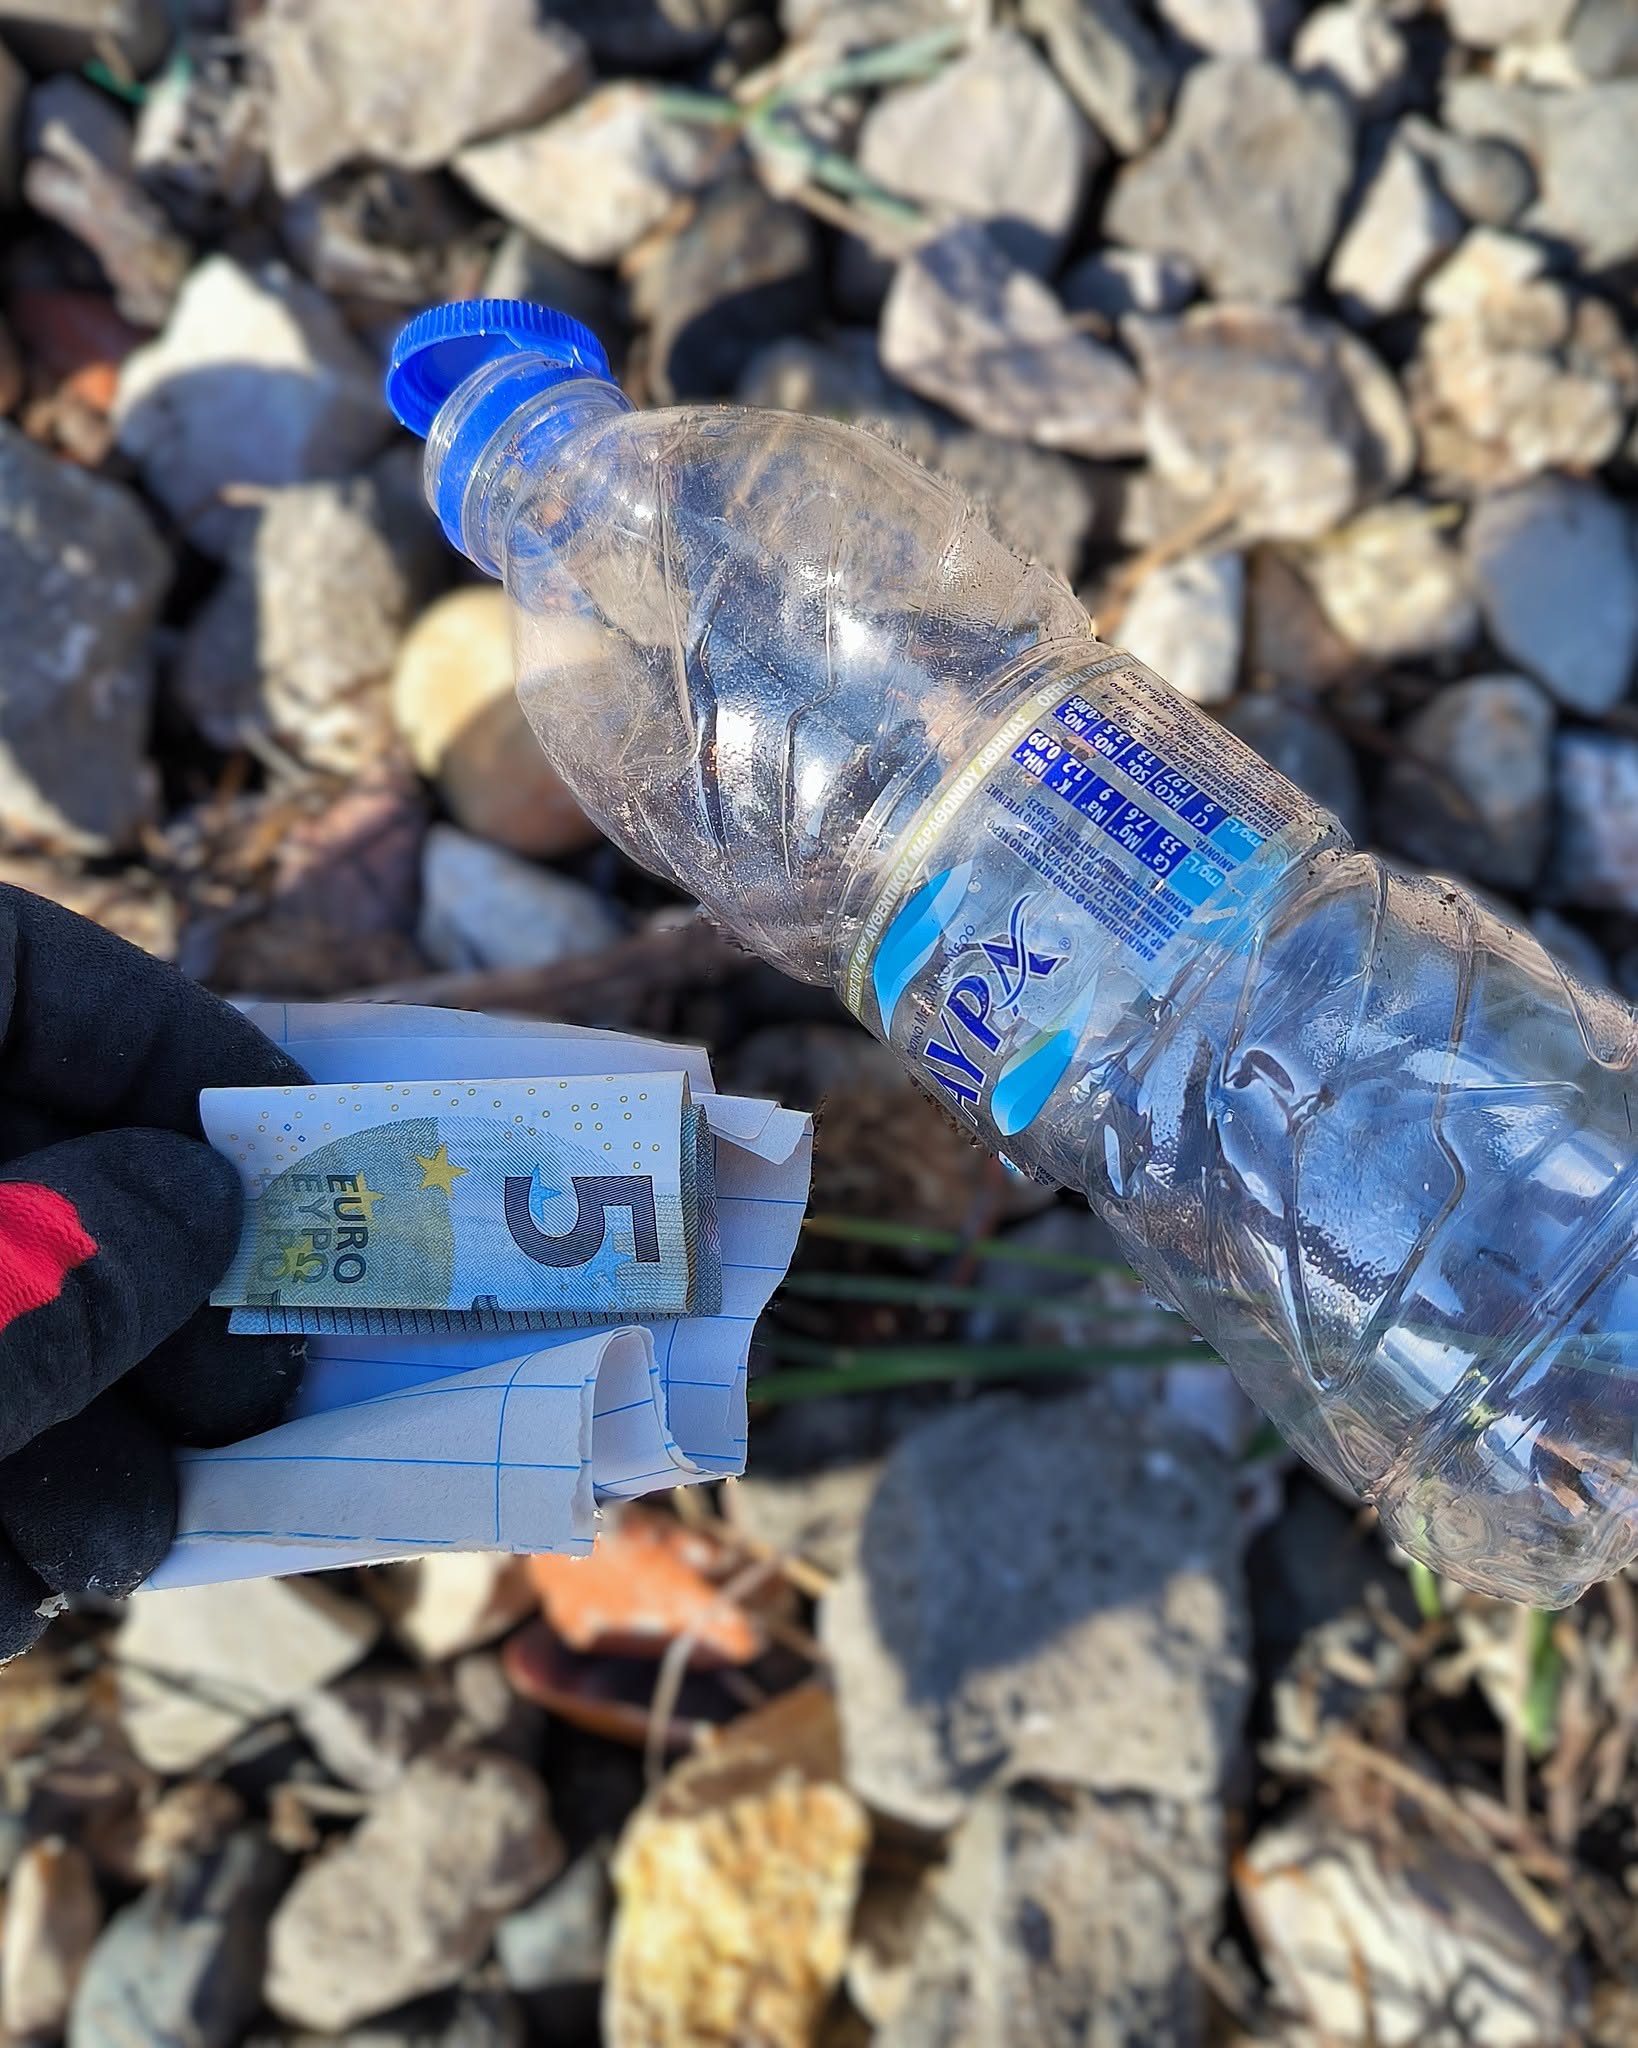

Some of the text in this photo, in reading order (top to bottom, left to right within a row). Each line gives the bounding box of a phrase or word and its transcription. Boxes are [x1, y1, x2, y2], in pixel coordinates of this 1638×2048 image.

[1036, 668, 1086, 707] OFFICIAL
[1068, 695, 1103, 723] <0.005
[1153, 714, 1176, 732] ΑΥΡΑ
[1026, 729, 1062, 760] 0.09
[1102, 723, 1129, 744] 3.5
[1060, 757, 1089, 781] 1.2
[1136, 748, 1157, 766] 13
[1097, 786, 1114, 801] 9
[1163, 769, 1191, 793] 197
[1123, 807, 1152, 831] 7.6
[1202, 801, 1217, 812] 9
[1244, 814, 1274, 837] ΟΛΙΚΗ
[851, 960, 862, 983] ΤΟΥ
[865, 859, 913, 940] ΑΥΘΕΝΤΙΚΟΥ
[908, 764, 979, 861] ΜΑΡΑΘΩΝΙΟΥ
[977, 711, 1030, 769] ΑΘΗΝΑΣ
[1007, 837, 1055, 879] ΜΕΤΑΛΛΙΚΟ
[1157, 834, 1182, 855] 53
[1190, 835, 1236, 872] ΑΝΙΟΝΤΑ:
[985, 782, 1175, 940] ΧΗΜΙΚΗ ΑΝΑΛΥΣΗ ΑΠΟ ΤΟ ΕΡΓΑΣΤΗΡΙΟ ΥΓΙΕΙΝΗΣ
[1022, 794, 1183, 928] ΤΟΥ ΠΑΝΕΠΙΣΤΗΜΙΟΥ ΠΑΤΡΩΝ 1/6/2023:
[1051, 873, 1086, 906] ΦΥΣΙΚΟ
[1081, 899, 1156, 962] ΑΝΑΓΝΩΡΙΣΜΕΝΟ
[1104, 898, 1150, 939] ΕΓΚΡΙΣΗΣ:
[1146, 932, 1165, 951] ΑΡ.
[921, 888, 1065, 1126] ΑΥΡΑ
[326, 1174, 368, 1284] EURO
[505, 1176, 661, 1267] 5
